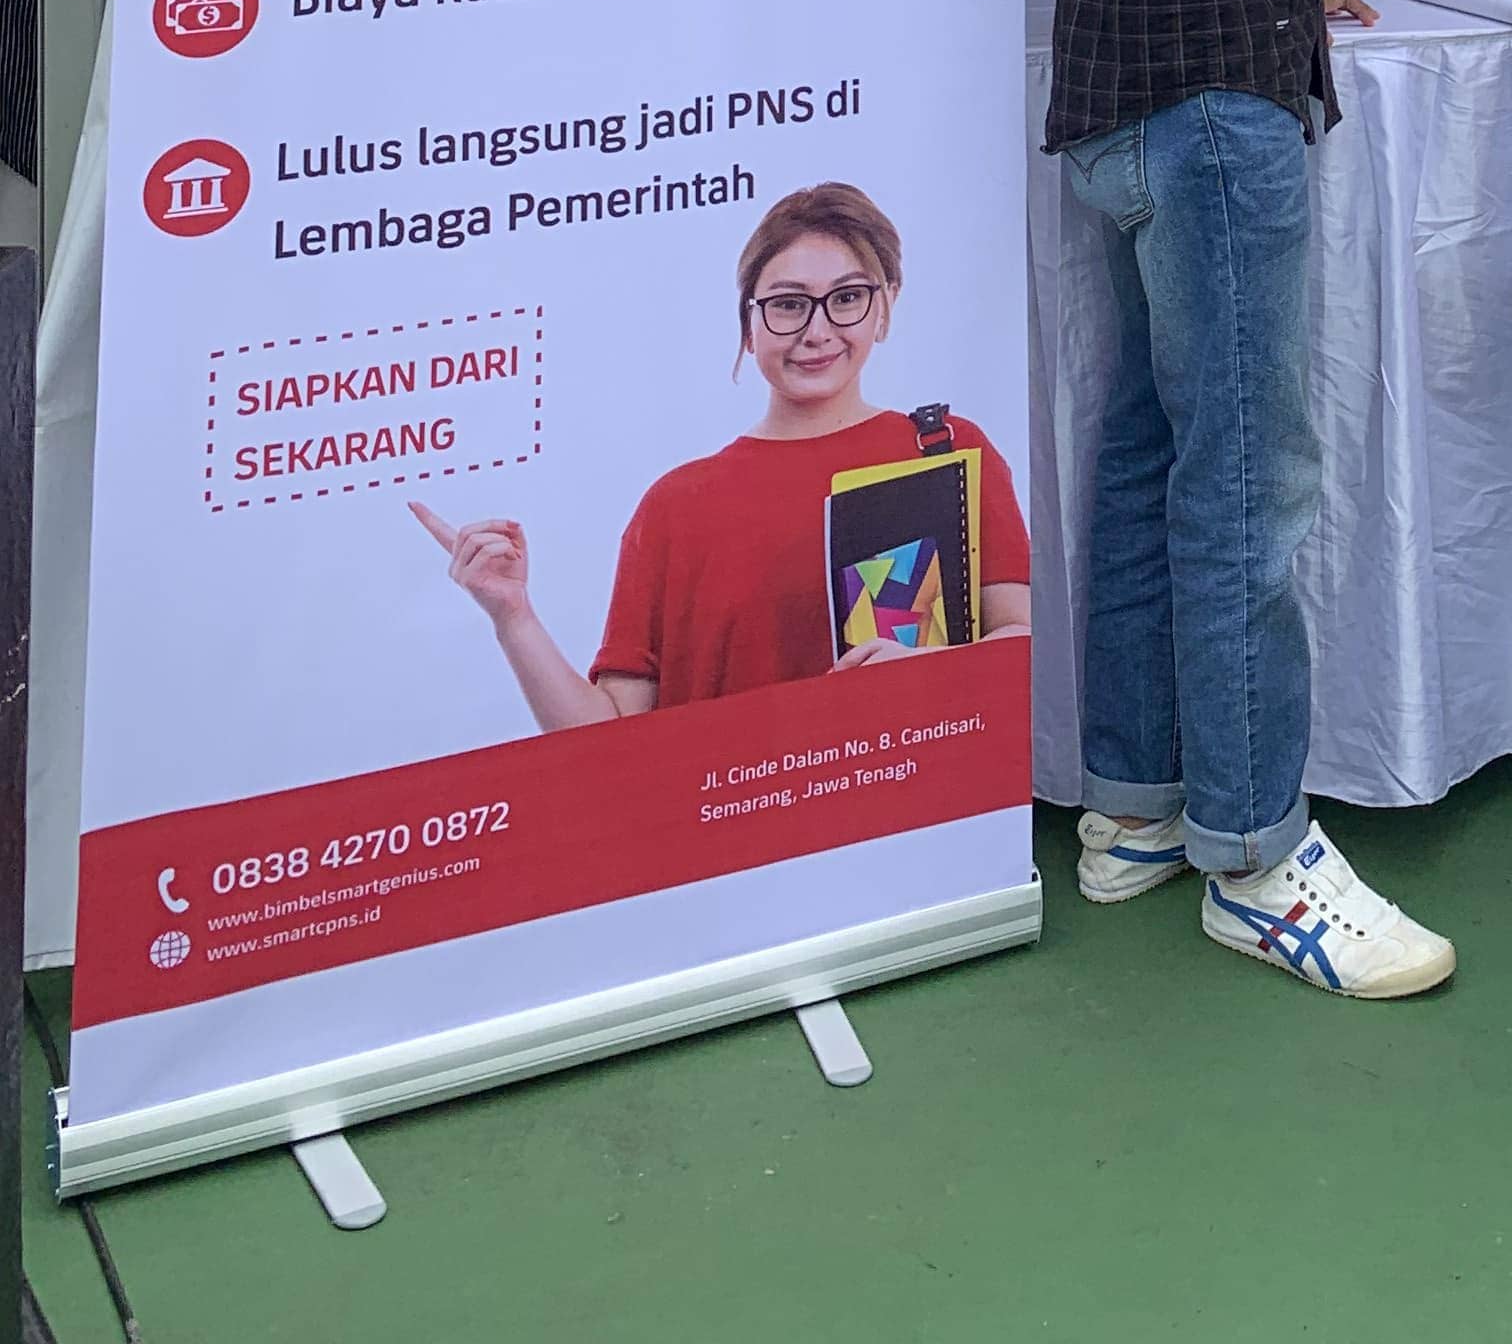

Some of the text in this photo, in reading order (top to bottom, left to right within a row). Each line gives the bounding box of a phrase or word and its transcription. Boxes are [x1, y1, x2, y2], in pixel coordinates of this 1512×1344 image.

[278, 79, 859, 181] Lulus langsung jadi PNS di
[275, 164, 753, 259] Lembaga Pemerintah
[237, 346, 517, 415] SIAPKAN DARI
[235, 418, 454, 480] SEKARANG
[701, 714, 985, 790] Jl. Cinde Dalam No. 8. Candisari,
[701, 759, 916, 821] Semarang, Jawa Tenagh
[214, 802, 508, 893] 0838 4270 0872
[208, 857, 479, 931] www.bimbelsmartgenius.com
[208, 906, 381, 962] www.smartcpns.id
